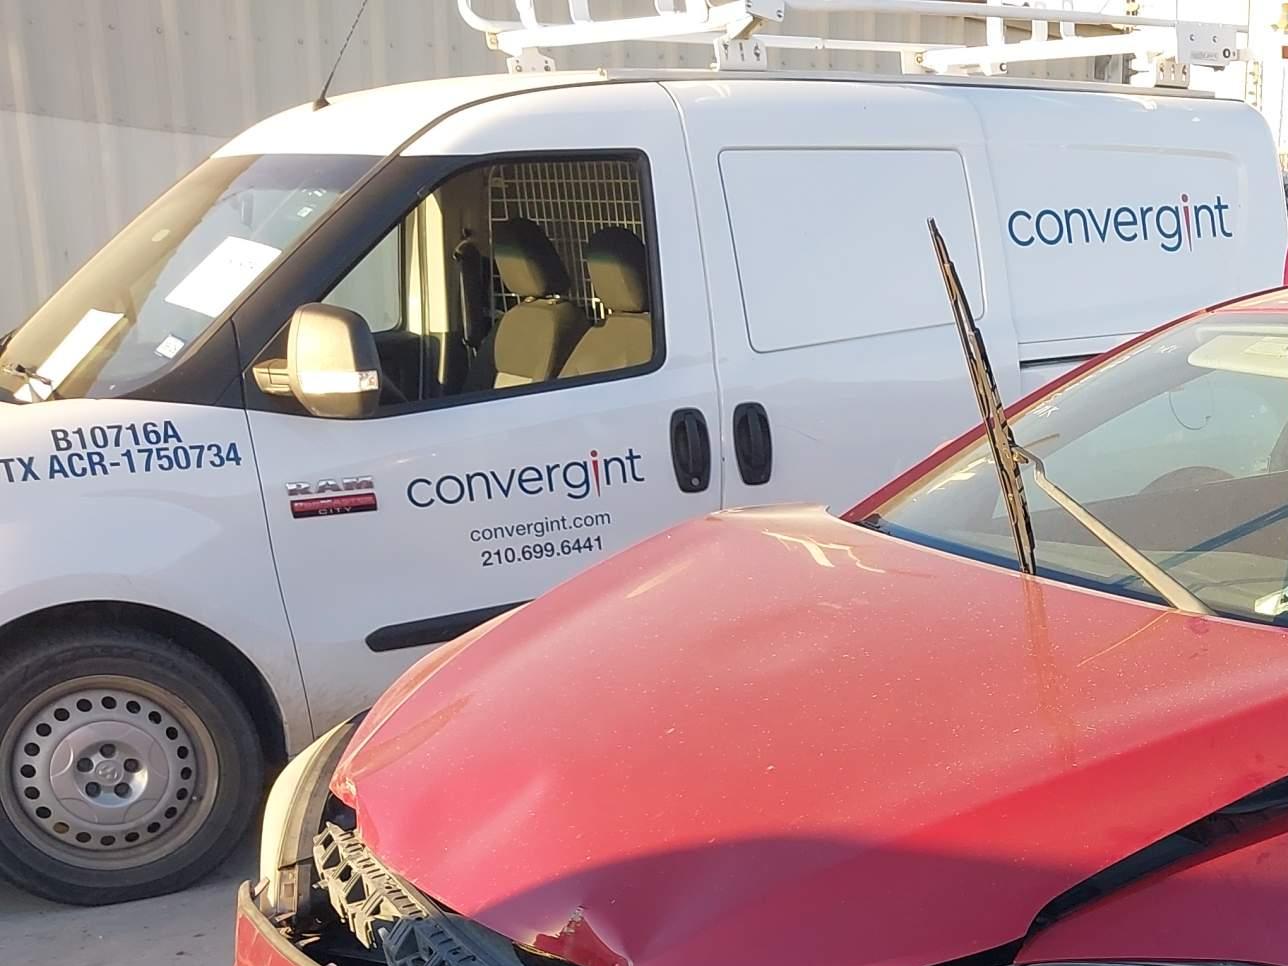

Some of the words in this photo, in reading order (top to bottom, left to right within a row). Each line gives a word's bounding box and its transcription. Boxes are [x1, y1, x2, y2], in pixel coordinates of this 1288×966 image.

[1008, 193, 1232, 252] convergint
[51, 420, 183, 451] B10716A
[0, 456, 40, 483] TX
[49, 442, 242, 479] ACR-1750734
[406, 448, 645, 508] convergint
[286, 475, 374, 497] RAM
[318, 506, 352, 515] CITY
[470, 512, 611, 543] convergint.com
[481, 535, 603, 567] 210.699.6441
